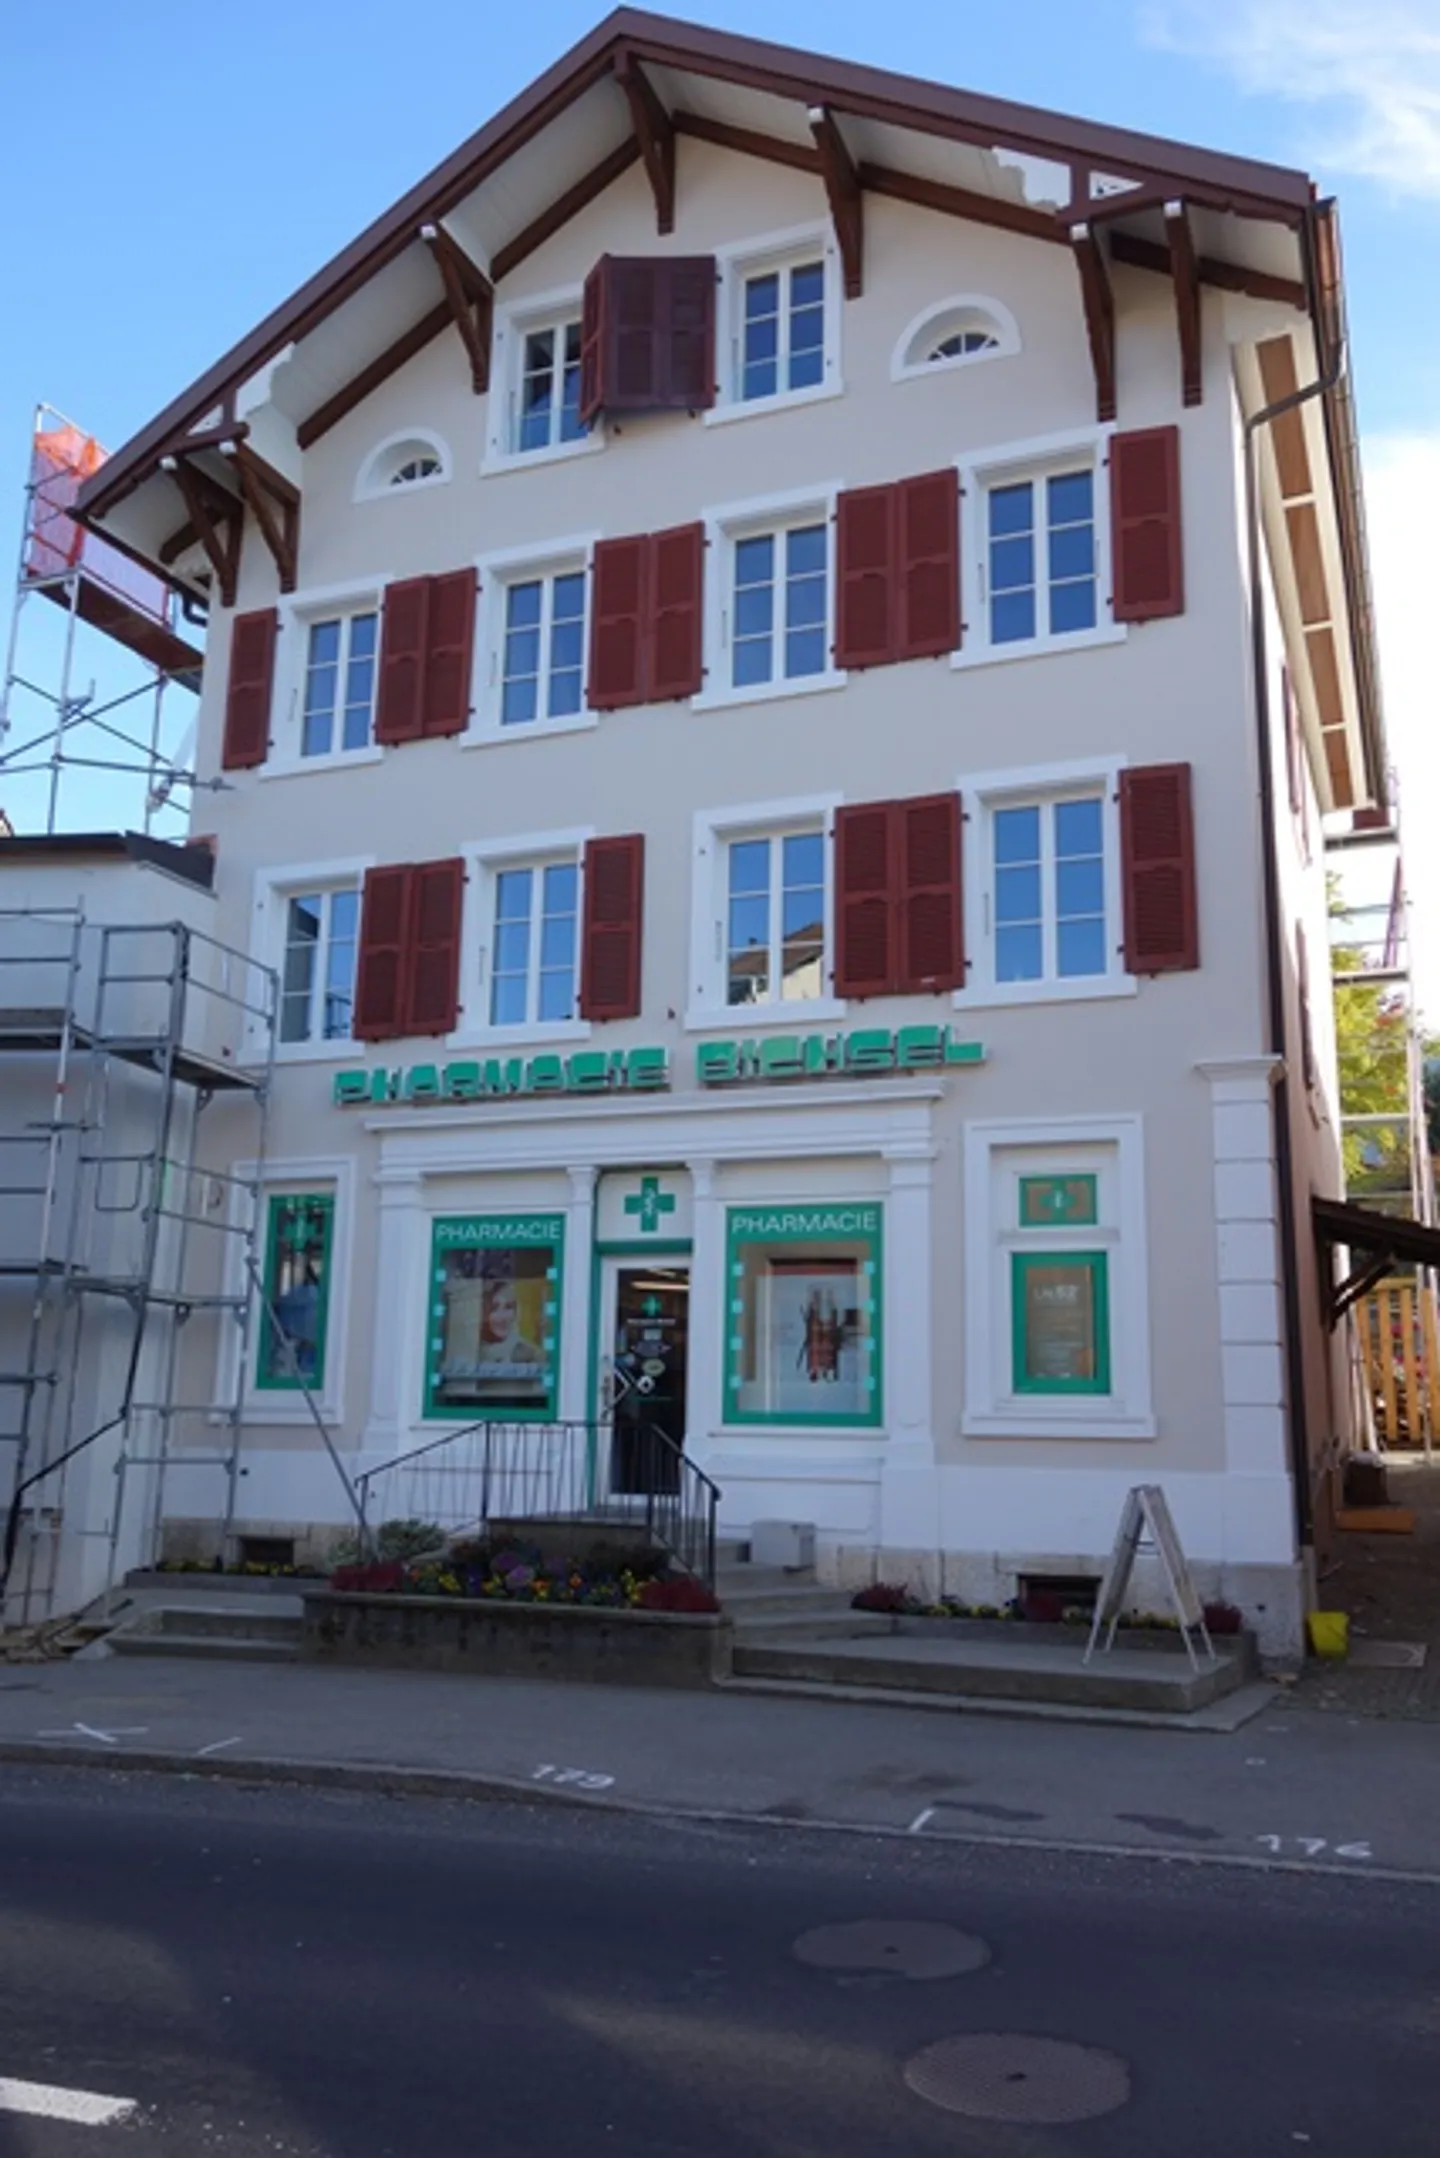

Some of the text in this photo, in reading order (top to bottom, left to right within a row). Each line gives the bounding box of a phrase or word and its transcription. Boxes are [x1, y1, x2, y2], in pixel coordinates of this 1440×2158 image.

[334, 1047, 671, 1104] PHARMACIE
[436, 1221, 561, 1241] PHARMACIE
[731, 1210, 878, 1234] PHARMACIE
